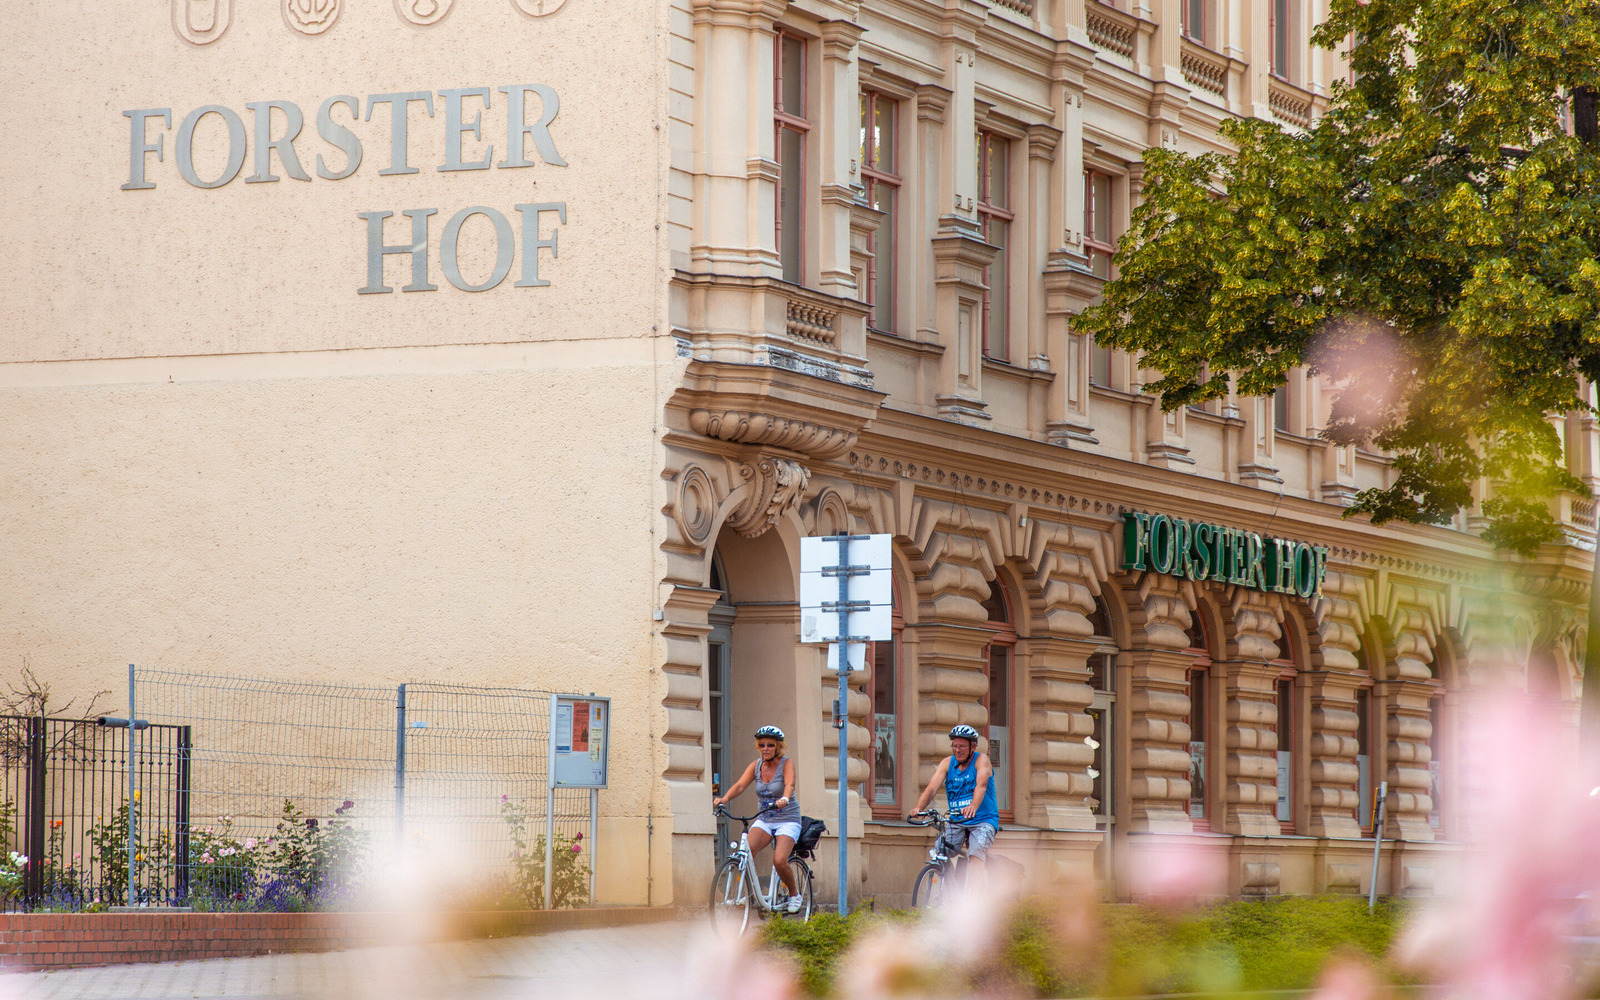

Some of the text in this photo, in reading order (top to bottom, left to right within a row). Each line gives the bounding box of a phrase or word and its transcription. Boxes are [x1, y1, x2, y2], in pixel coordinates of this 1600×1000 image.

[121, 83, 568, 190] FORSTER
[358, 202, 567, 294] HOF
[1124, 512, 1328, 599] FORSTER HOF
